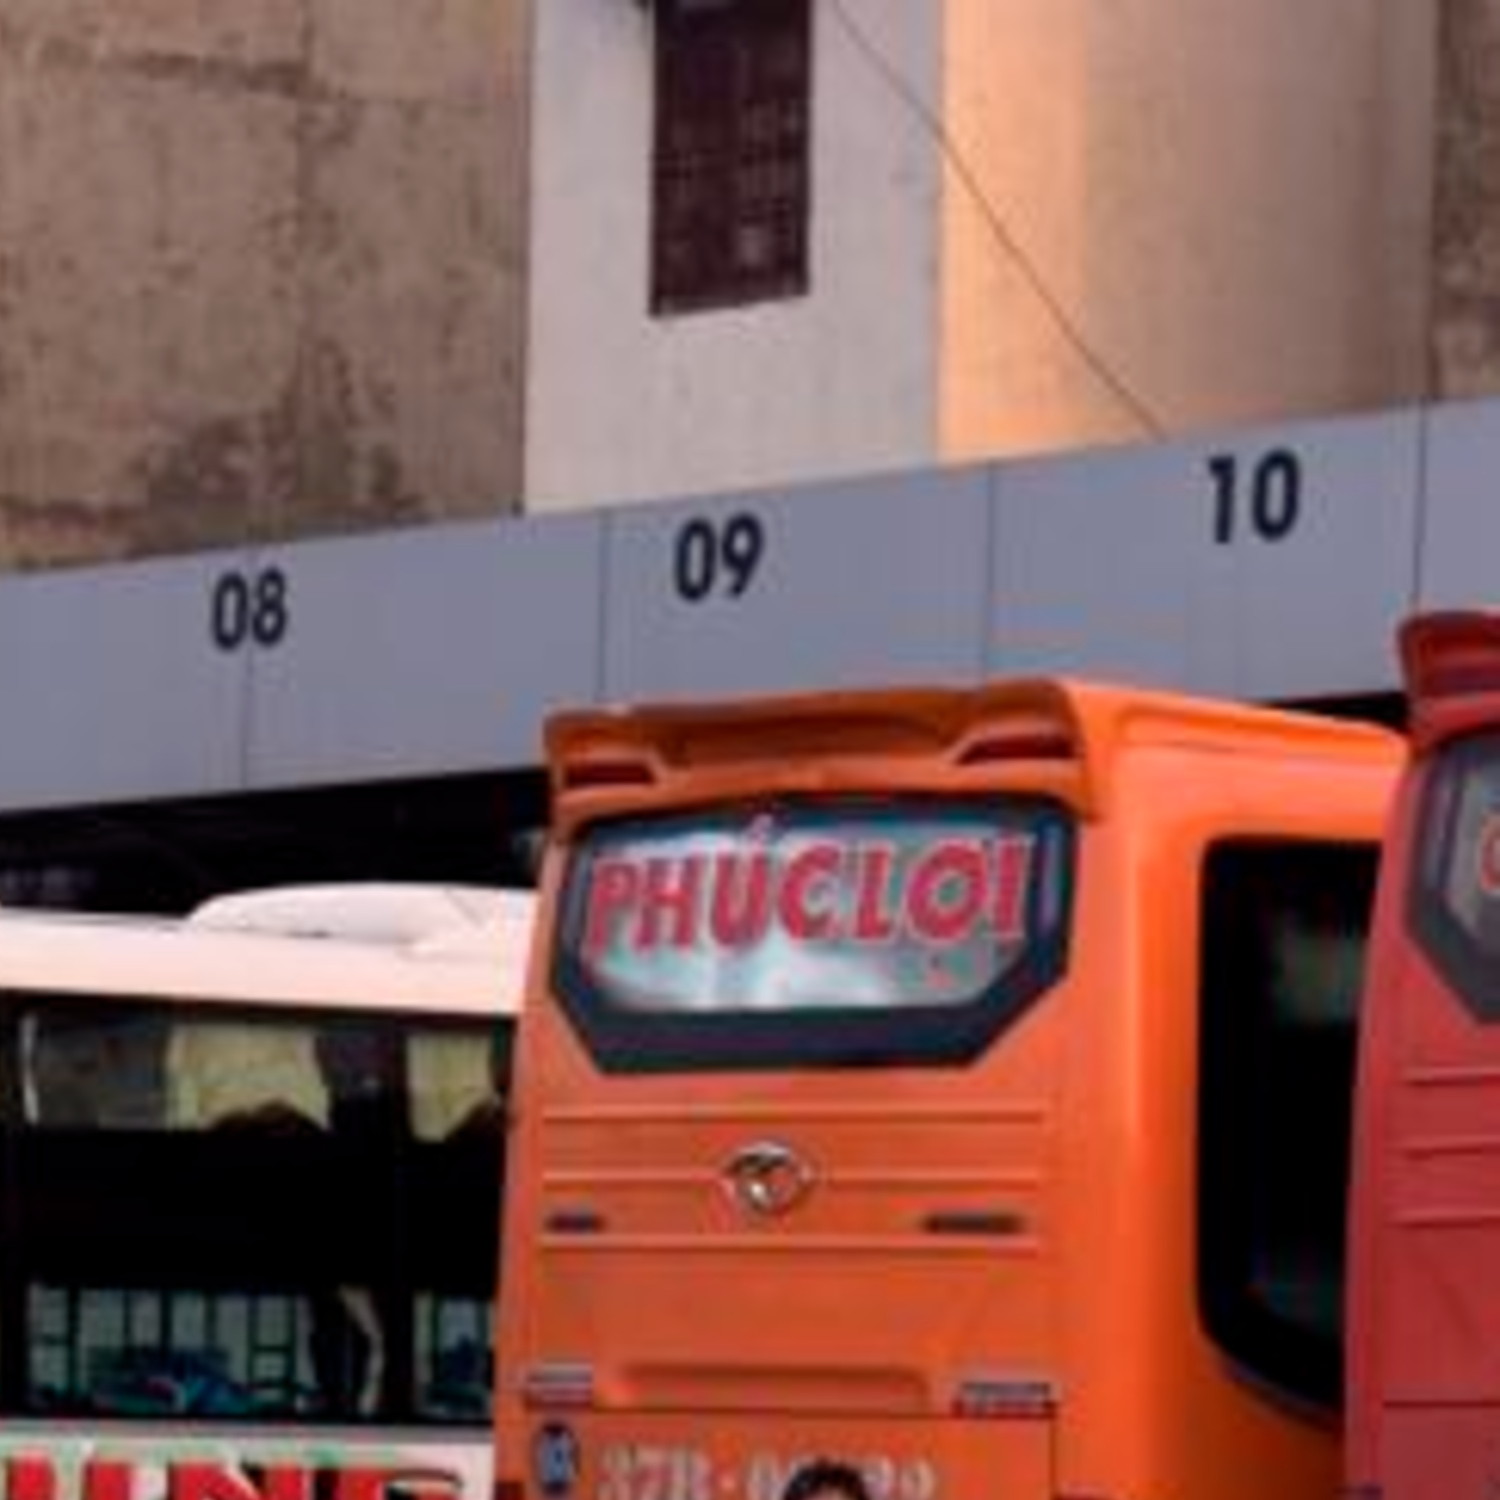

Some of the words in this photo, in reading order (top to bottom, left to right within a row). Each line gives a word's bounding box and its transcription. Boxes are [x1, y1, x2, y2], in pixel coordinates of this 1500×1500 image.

[1207, 447, 1300, 545] 10
[674, 511, 764, 602] 09
[211, 567, 287, 653] 08
